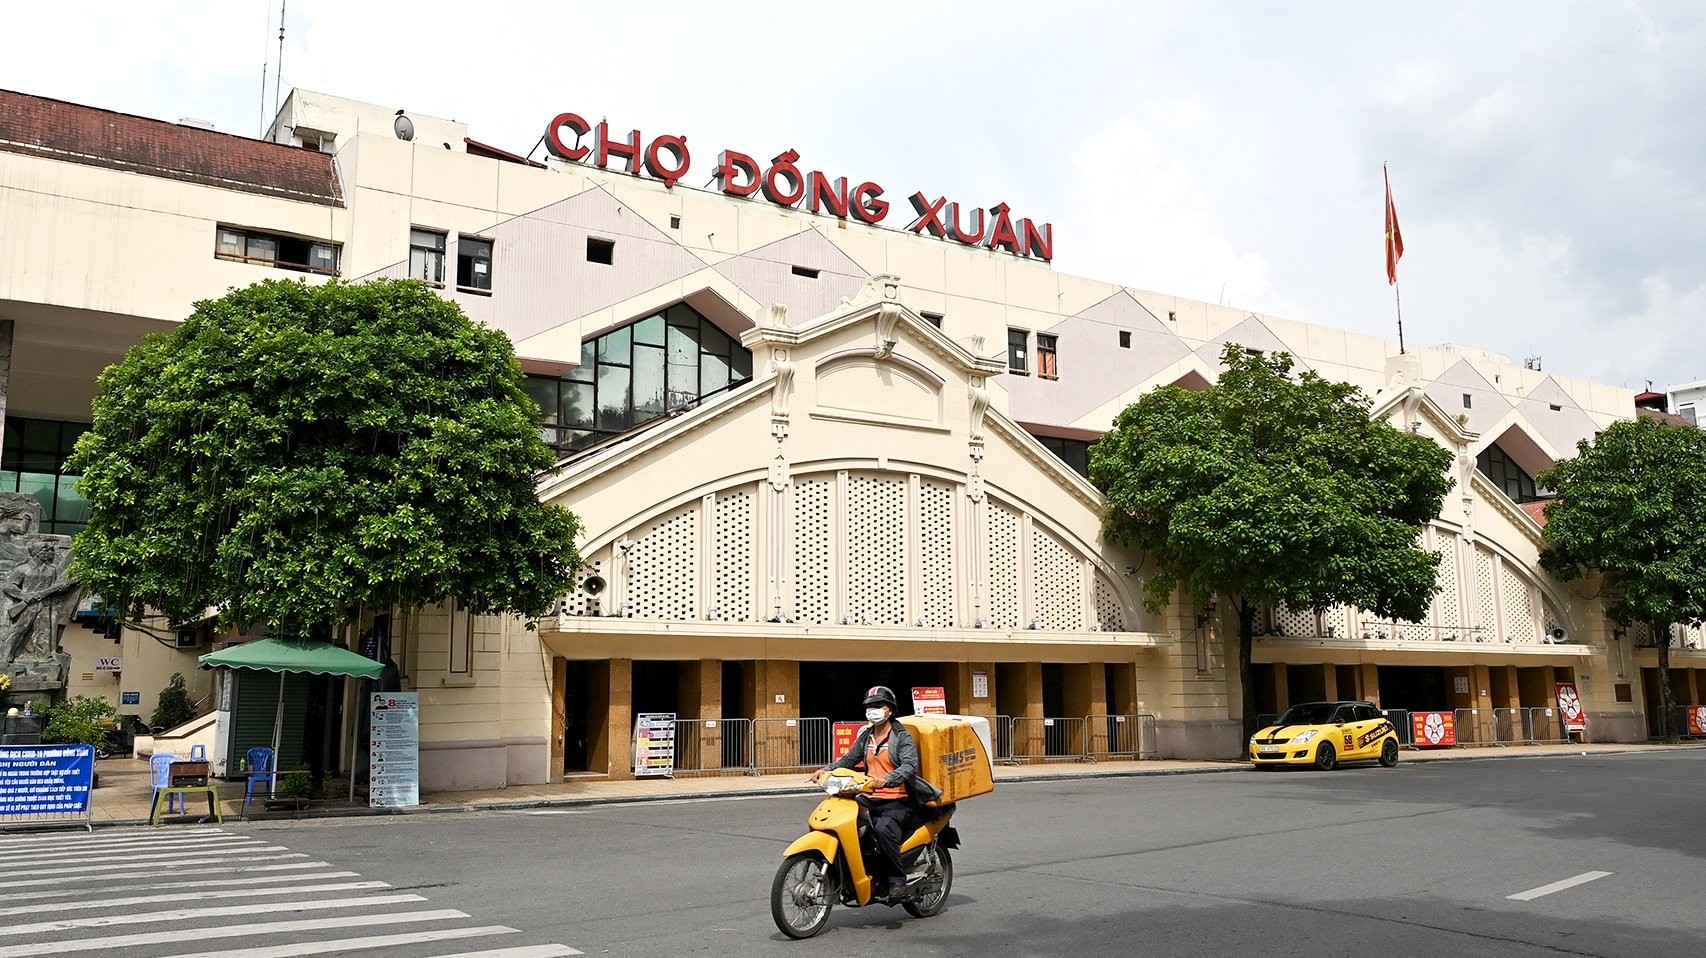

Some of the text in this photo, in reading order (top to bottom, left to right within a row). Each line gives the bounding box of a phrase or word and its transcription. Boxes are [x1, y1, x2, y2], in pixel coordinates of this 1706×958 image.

[544, 112, 690, 188] CHỢ
[908, 191, 1052, 260] XUÂN
[1370, 725, 1388, 739] SUZUKI
[1344, 735, 1352, 744] 68
[948, 751, 963, 766] EMS
